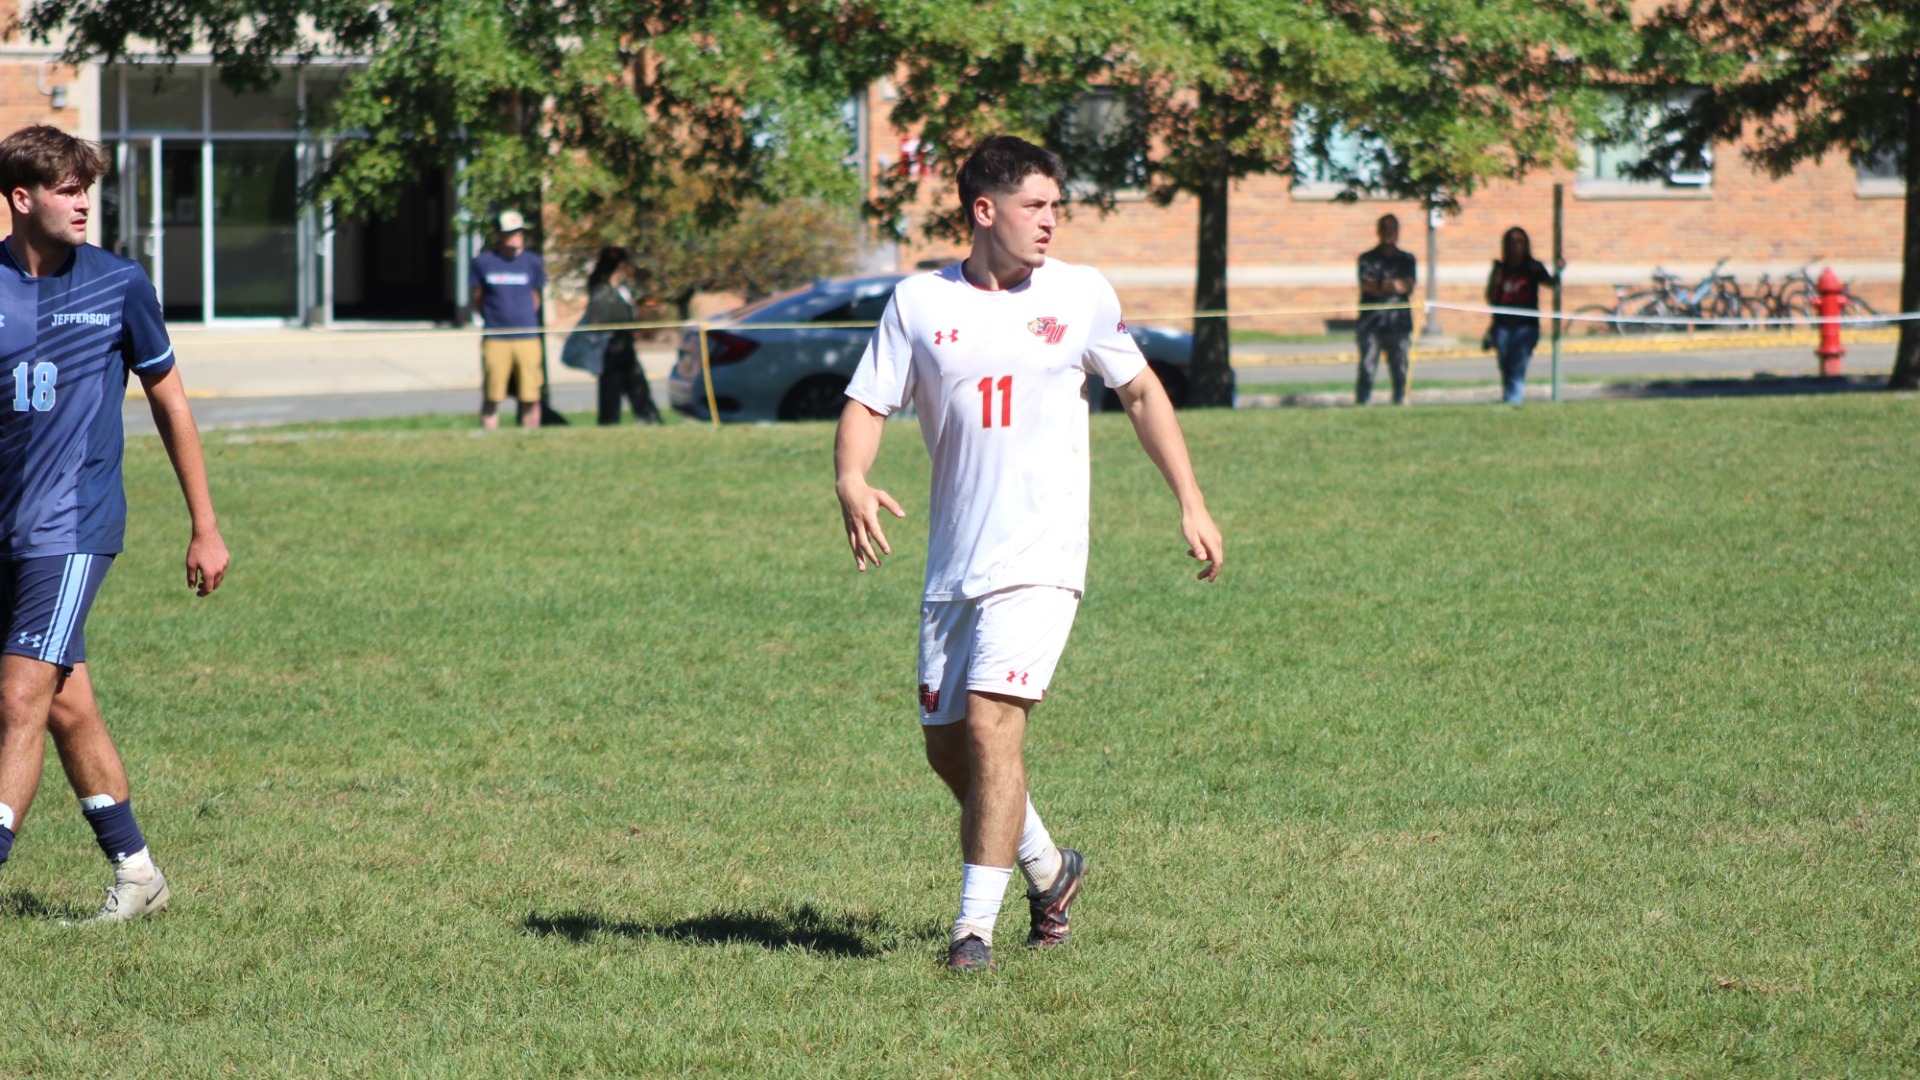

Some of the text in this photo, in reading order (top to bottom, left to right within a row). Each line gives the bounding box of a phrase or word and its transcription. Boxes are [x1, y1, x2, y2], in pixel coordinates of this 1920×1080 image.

[51, 313, 111, 327] JEFFERSON
[12, 361, 58, 412] 18
[977, 375, 1013, 429] 11
